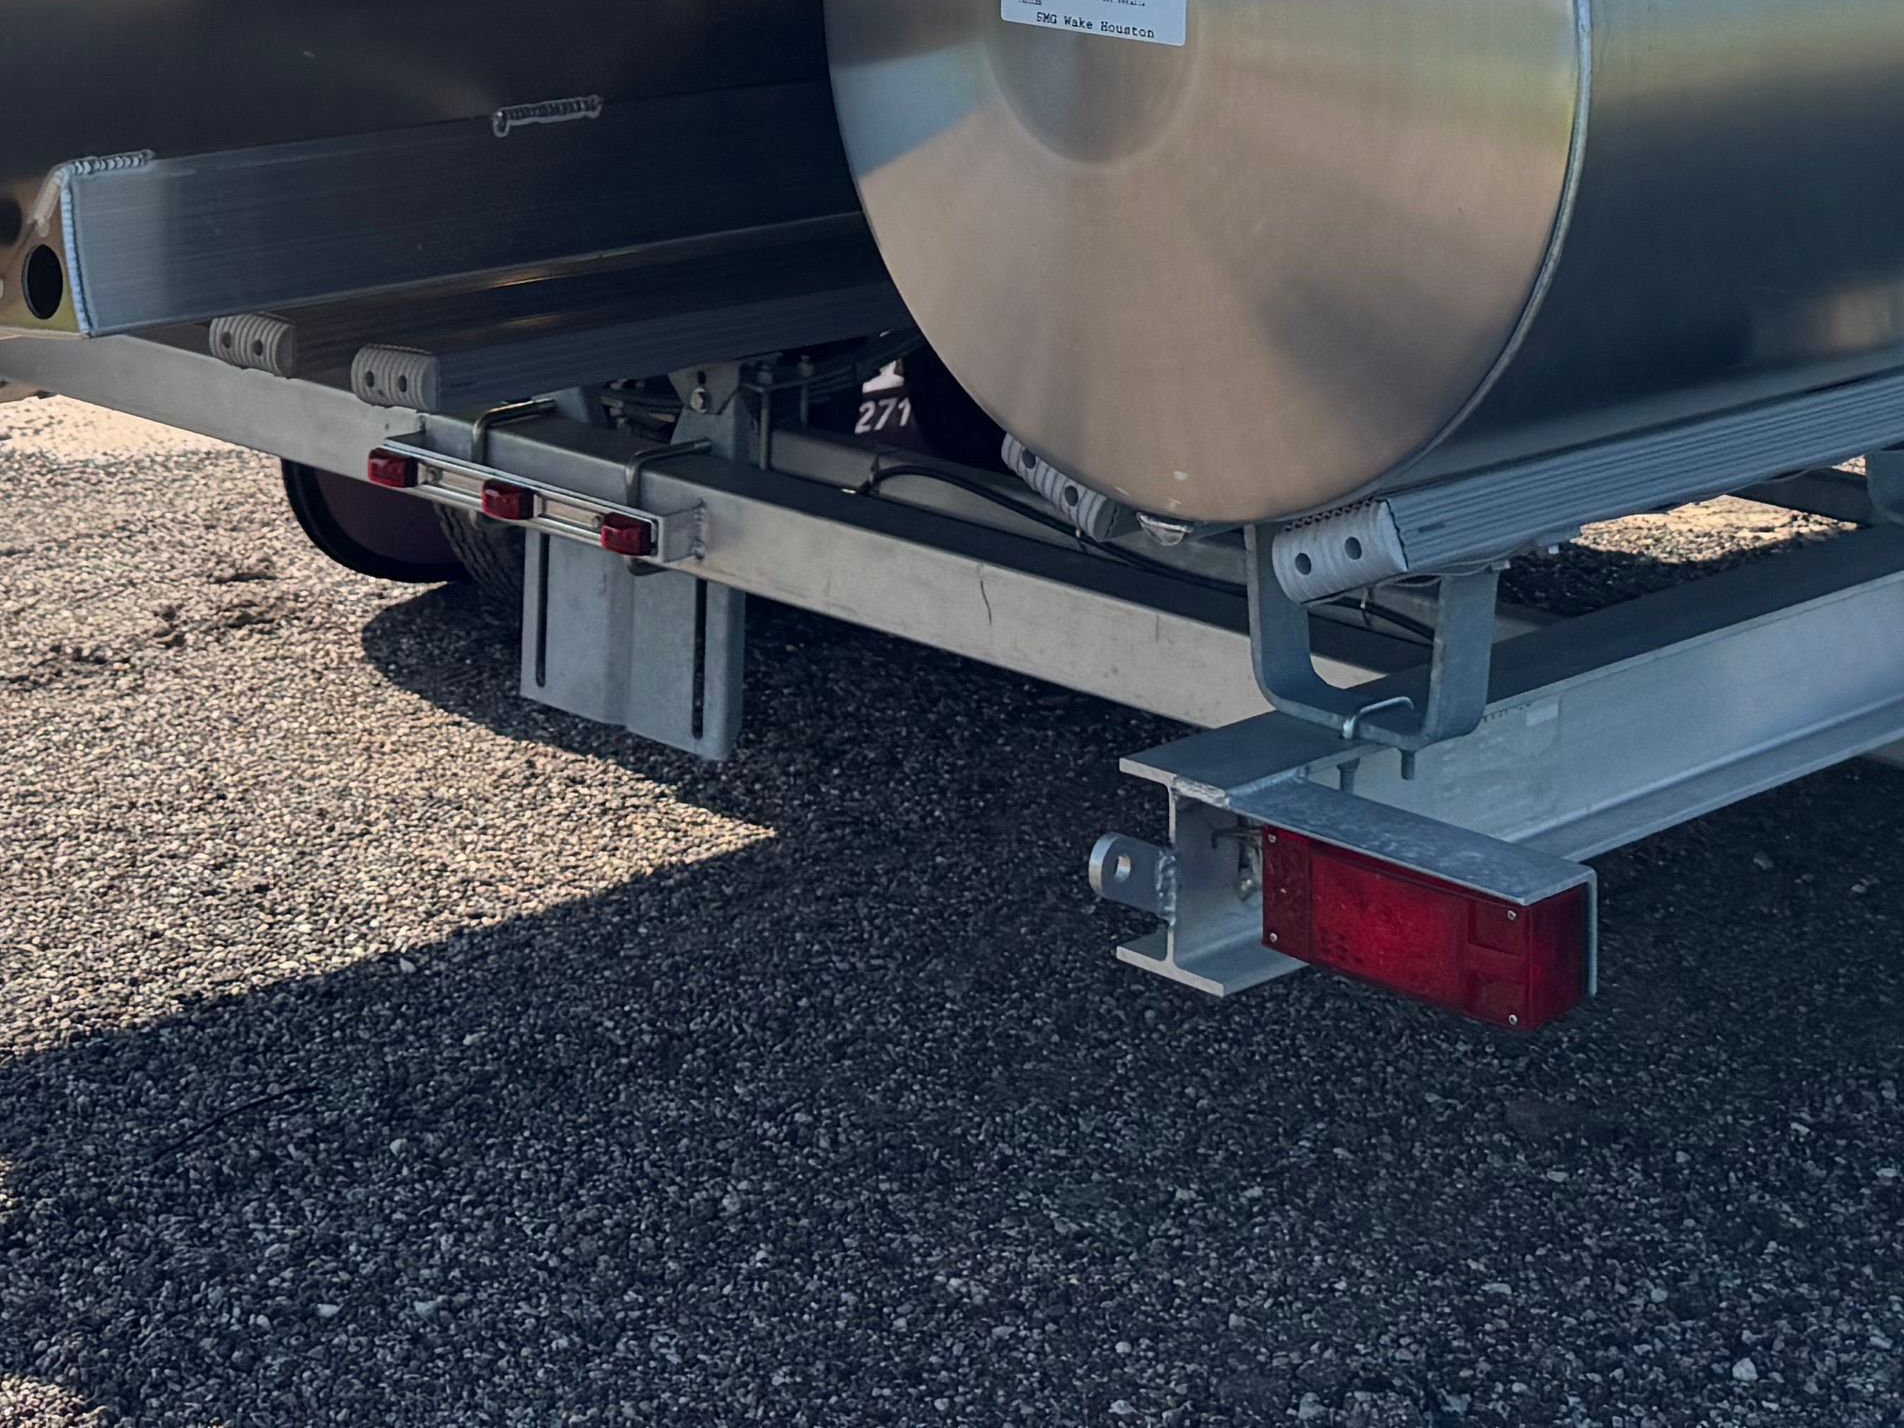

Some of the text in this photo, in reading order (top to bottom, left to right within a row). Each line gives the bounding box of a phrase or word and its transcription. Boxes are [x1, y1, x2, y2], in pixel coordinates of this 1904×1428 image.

[1036, 12, 1154, 38] SMG Wake Houston
[854, 397, 911, 434] 271
